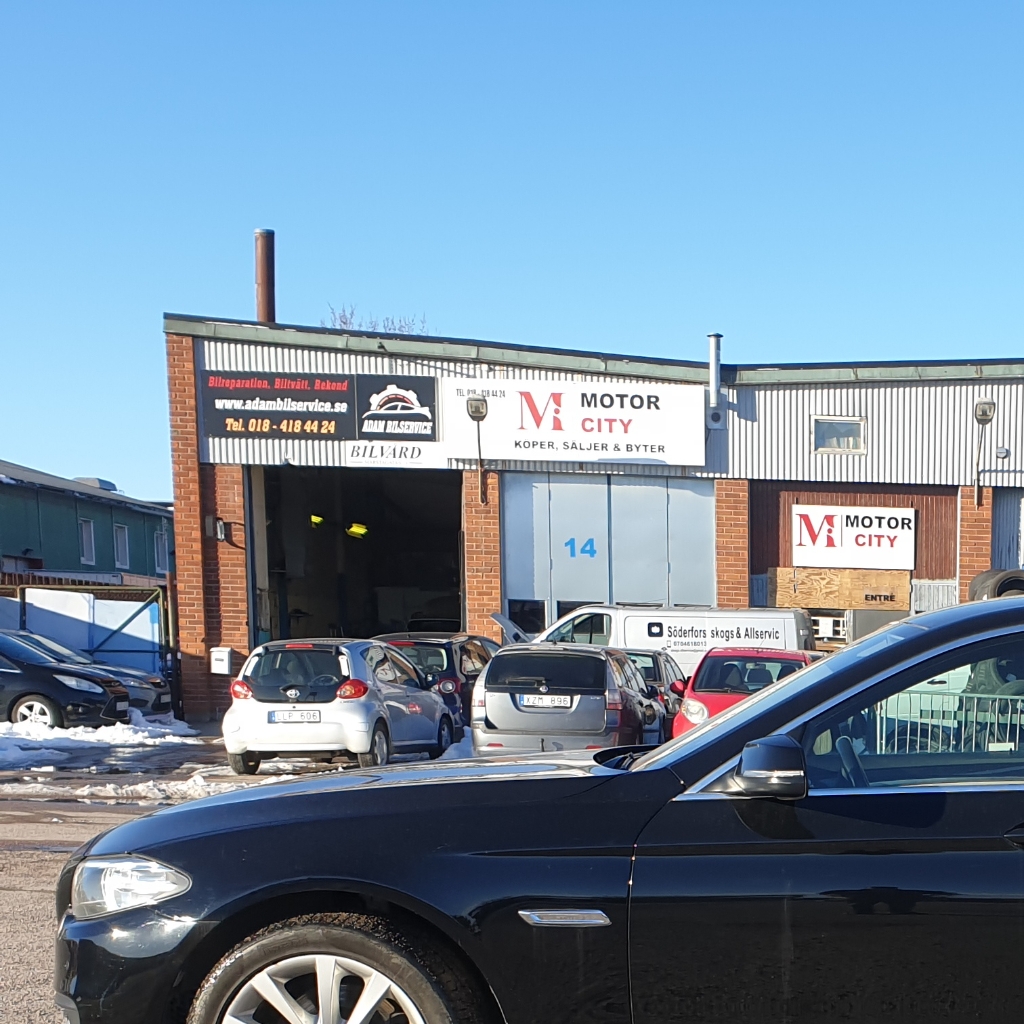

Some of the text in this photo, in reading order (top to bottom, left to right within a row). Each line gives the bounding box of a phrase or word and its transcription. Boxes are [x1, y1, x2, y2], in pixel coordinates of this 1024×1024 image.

[214, 397, 349, 413] www.adambilservice.se
[580, 392, 661, 411] MOTOR
[225, 418, 245, 432] Tel.
[248, 418, 270, 432] 018
[279, 419, 302, 433] 418
[303, 420, 319, 433] 44
[320, 420, 336, 434] 24
[362, 419, 433, 434] ADAM BILSERVICE
[581, 417, 633, 434] CITY
[350, 444, 422, 459] BILVÅRD
[562, 440, 609, 452] SÄLJER
[613, 443, 621, 452] &
[625, 444, 666, 454] BYTER
[845, 514, 912, 531] MOTOR
[564, 537, 597, 558] 14
[854, 534, 898, 548] CITY
[864, 593, 896, 602] ENTRÉ
[667, 625, 780, 642] Söderfors skogs & Allservic
[526, 697, 569, 706] XZM 896
[276, 712, 318, 721] LLP 606
